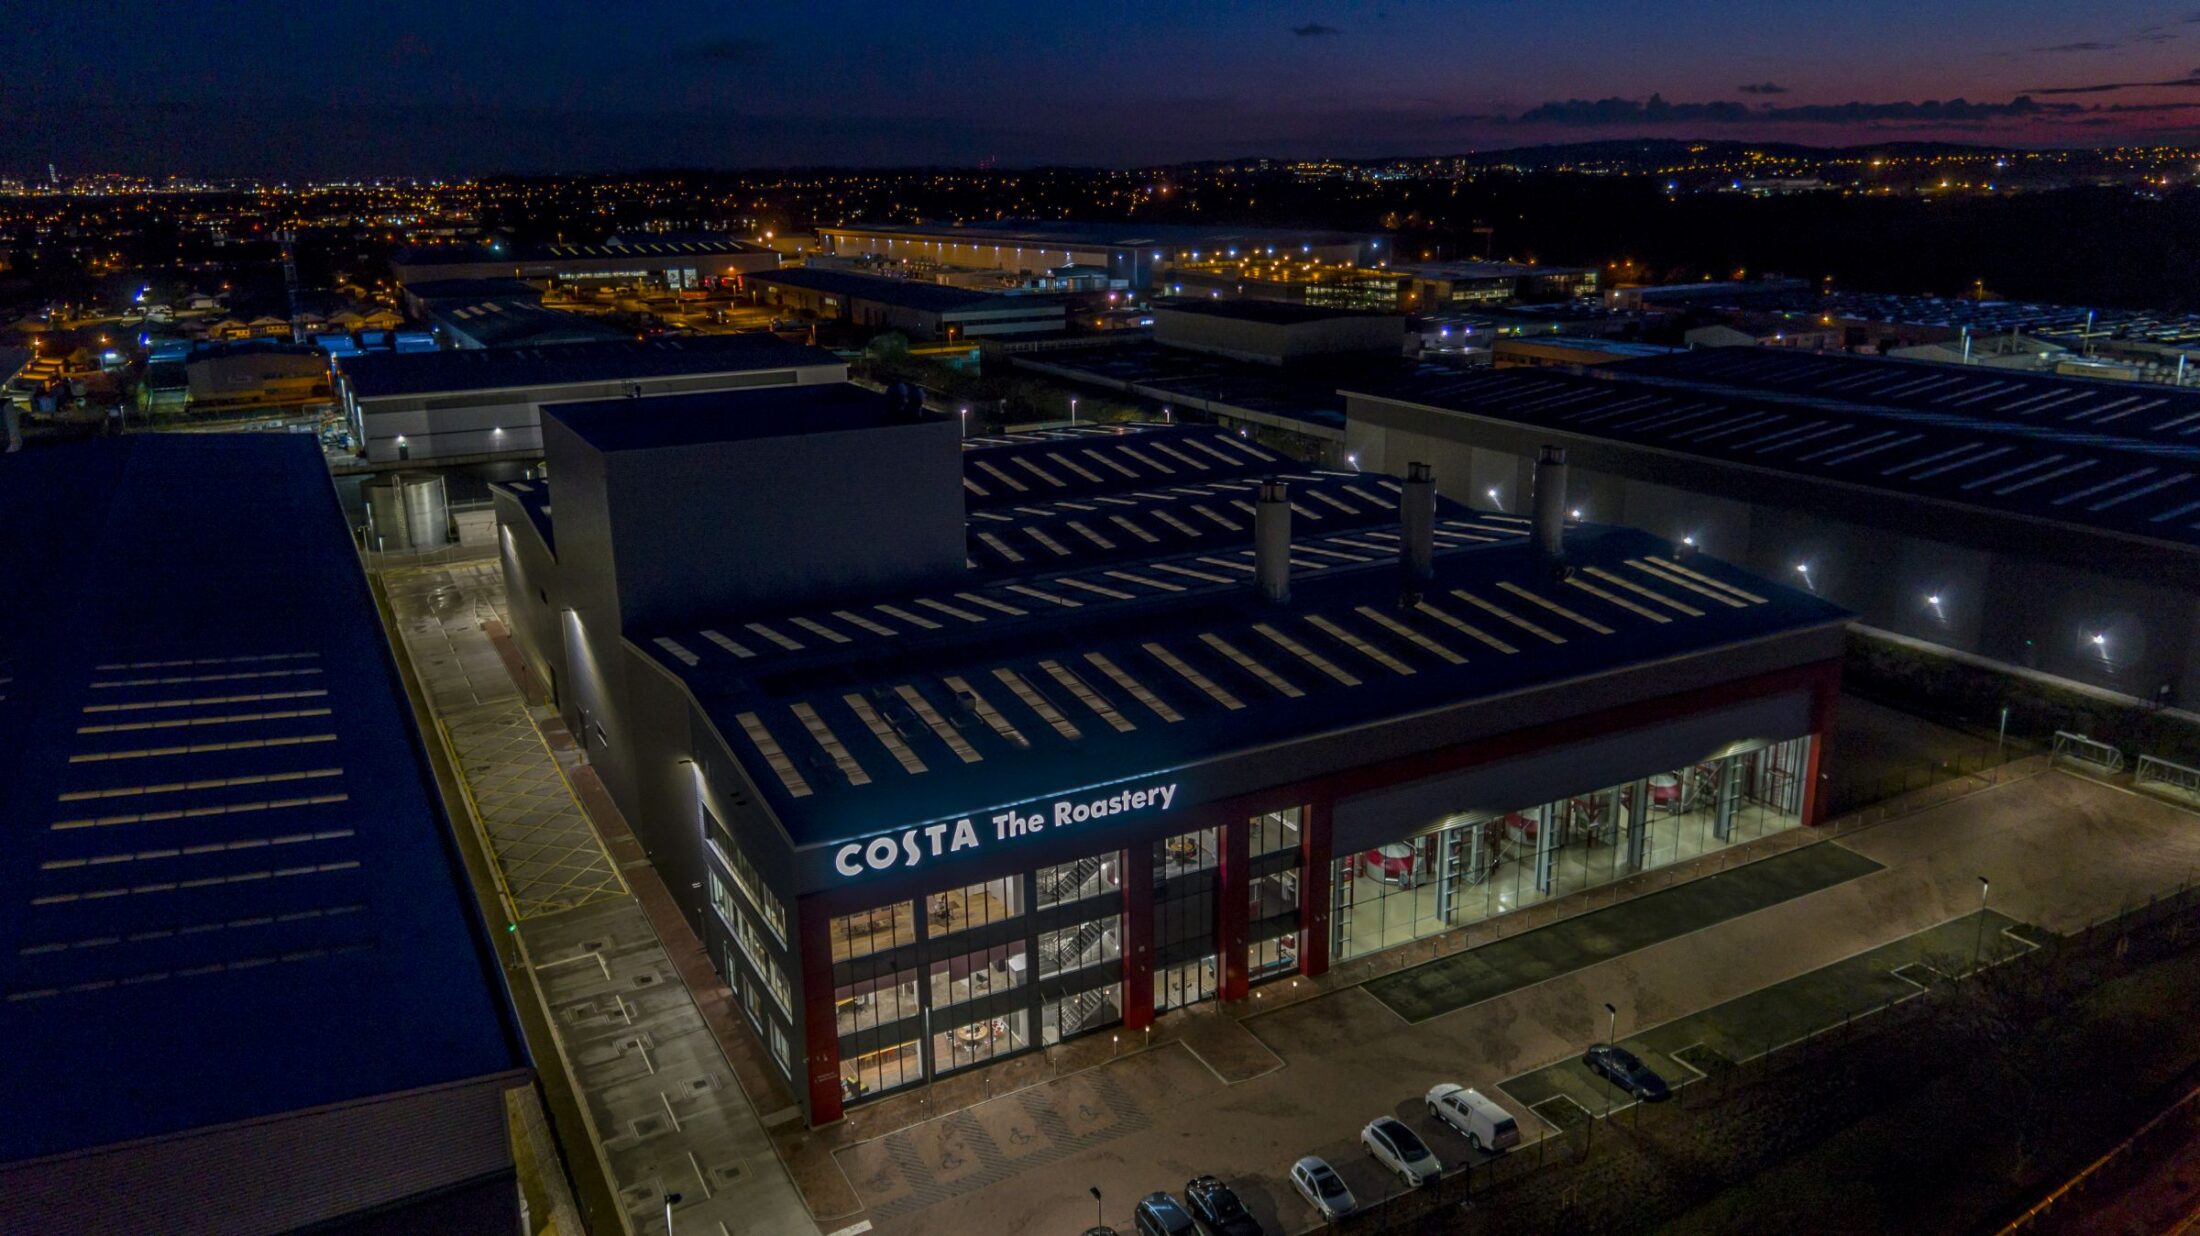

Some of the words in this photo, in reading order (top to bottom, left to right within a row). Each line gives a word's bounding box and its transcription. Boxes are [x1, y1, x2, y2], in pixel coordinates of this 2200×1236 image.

[835, 819, 979, 876] COSTA
[993, 811, 1044, 839] The
[1055, 784, 1177, 827] Roastery
